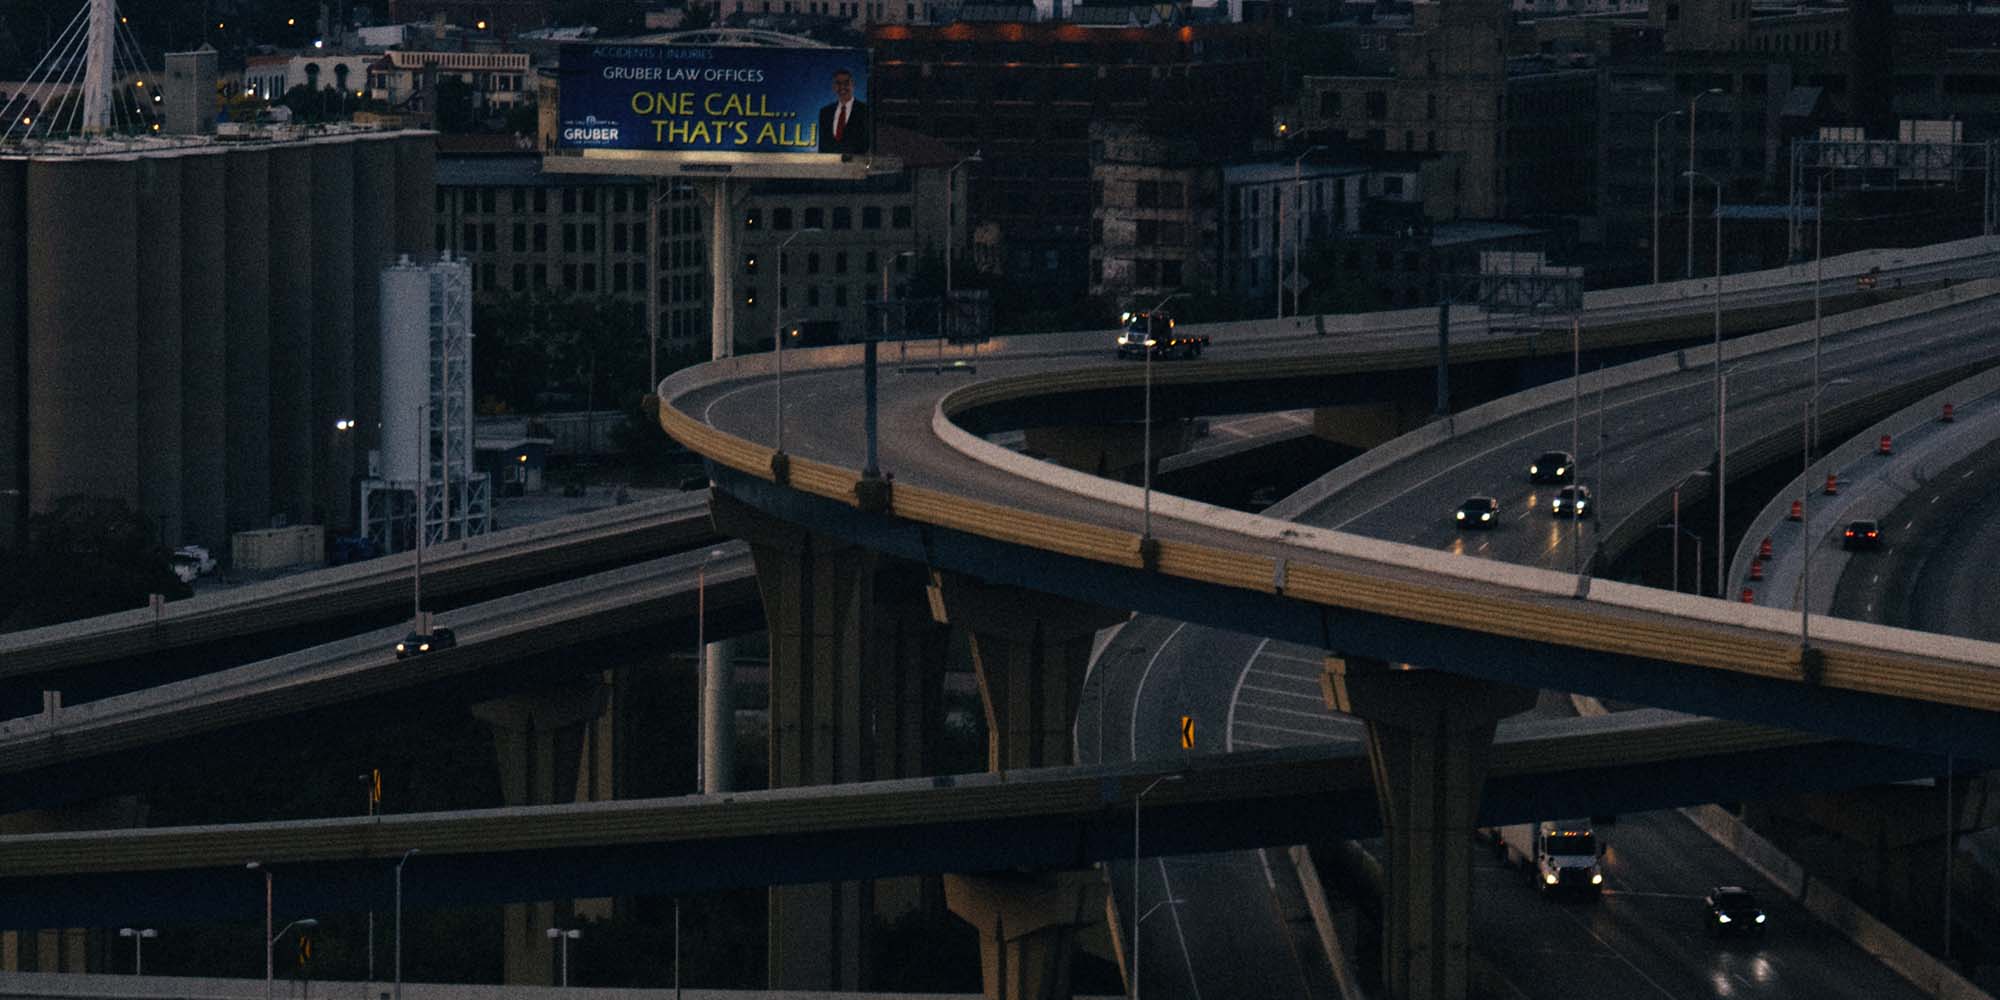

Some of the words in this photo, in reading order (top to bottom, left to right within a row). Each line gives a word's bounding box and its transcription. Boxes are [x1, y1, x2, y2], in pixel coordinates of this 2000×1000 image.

[603, 65, 662, 80] GRUBER
[666, 67, 700, 81] LAW
[704, 68, 764, 83] OFFICES
[631, 91, 695, 115] ONE
[704, 93, 796, 117] CALL...
[563, 128, 619, 141] GRUBER
[651, 119, 748, 144] THAT'S
[757, 122, 817, 147] ALL!
